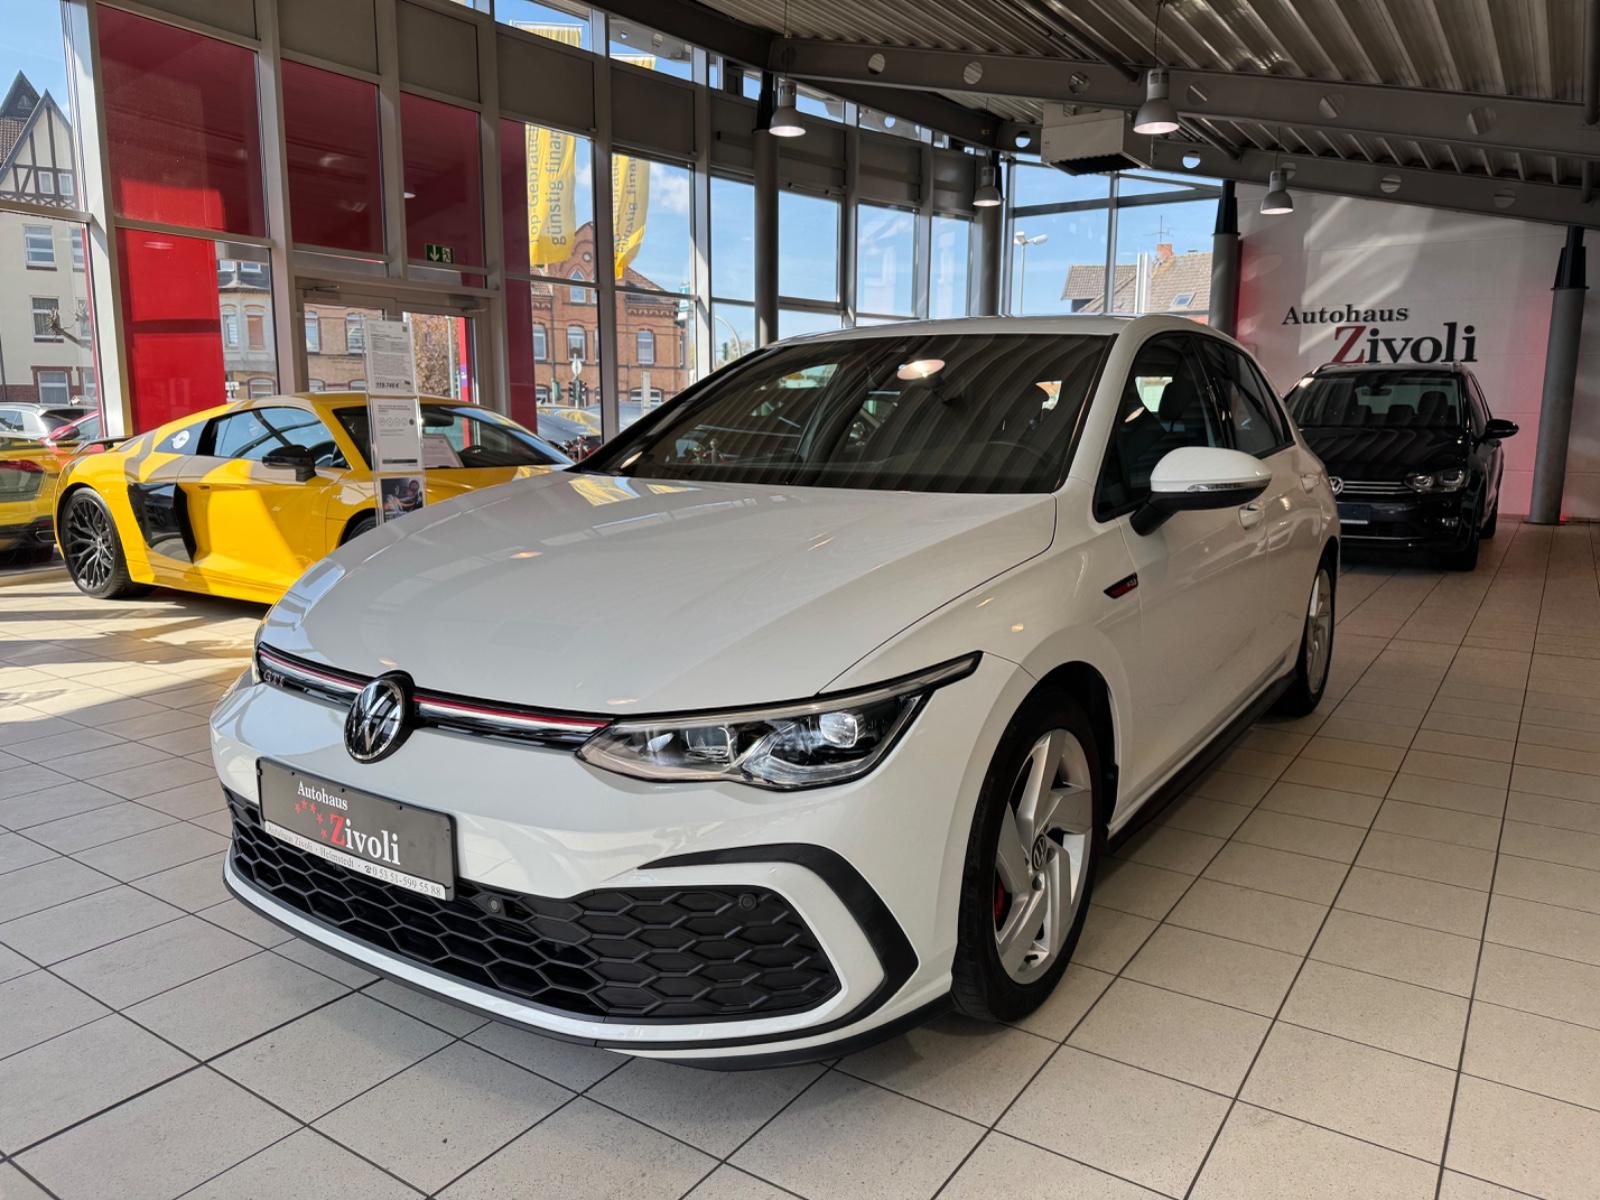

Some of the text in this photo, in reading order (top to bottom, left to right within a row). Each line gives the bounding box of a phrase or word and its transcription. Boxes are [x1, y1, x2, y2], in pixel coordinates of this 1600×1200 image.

[546, 180, 566, 245] günstig
[1282, 304, 1409, 325] Autohaus
[1331, 322, 1478, 364] Zivoli
[263, 669, 285, 688] GTI
[298, 781, 348, 811] Autohaus
[330, 813, 401, 865] Zivoli
[322, 847, 354, 868] Helmstedt
